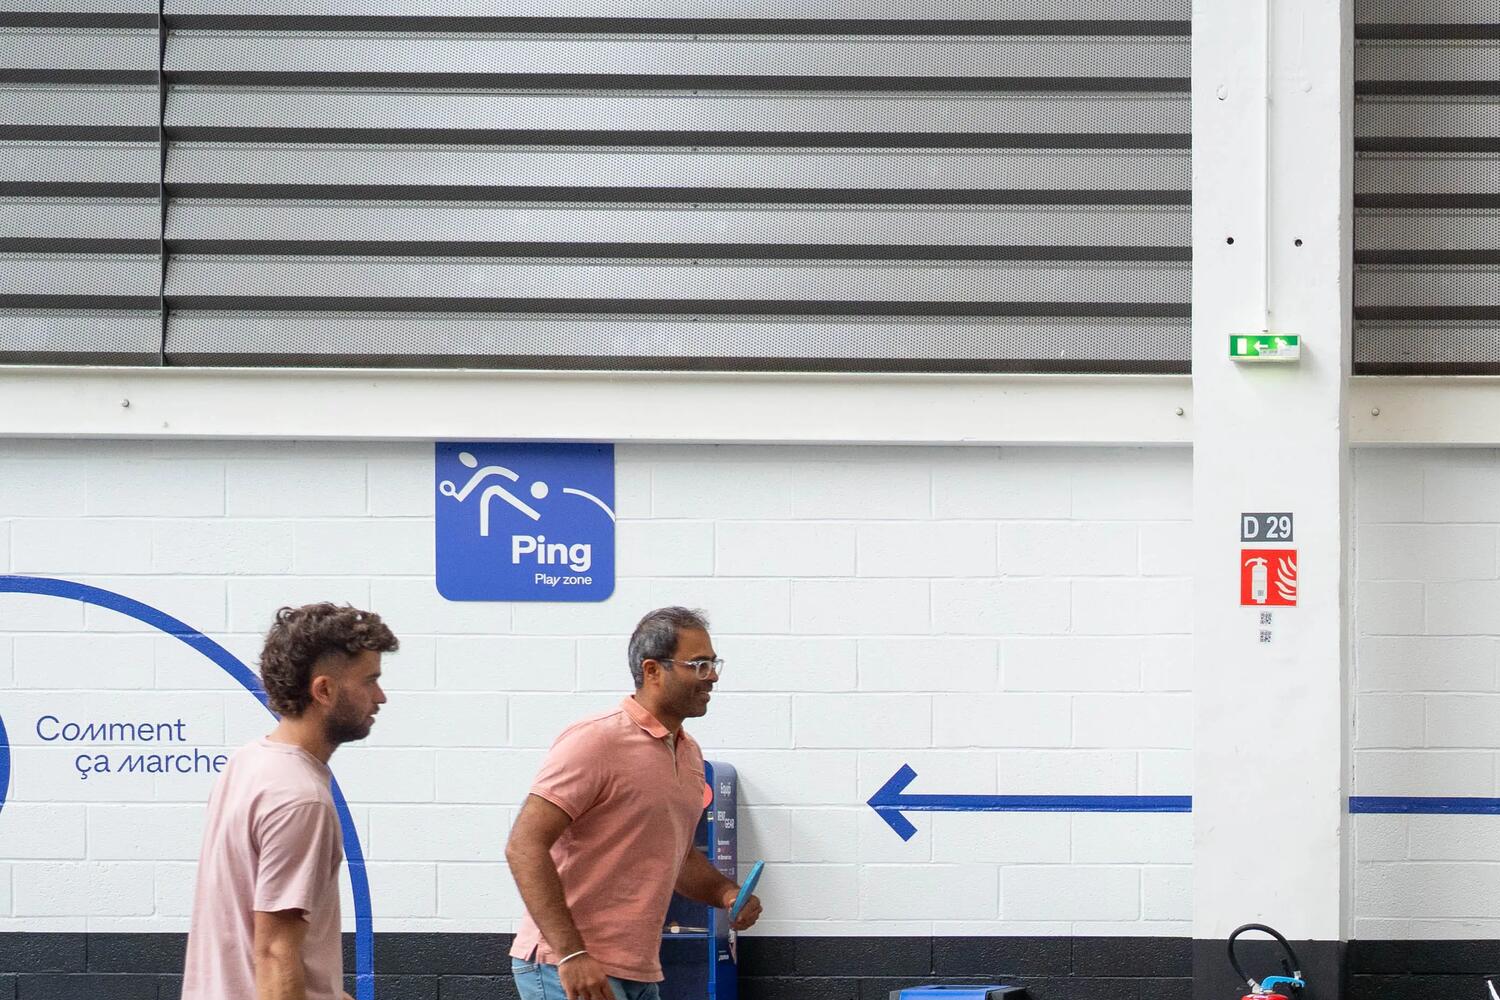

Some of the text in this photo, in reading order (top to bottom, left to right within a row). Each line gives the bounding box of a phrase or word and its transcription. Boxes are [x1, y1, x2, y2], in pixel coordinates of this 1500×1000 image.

[1243, 516, 1291, 539] D 29
[512, 535, 591, 572] Ping
[535, 573, 592, 587] Play zone
[36, 715, 187, 742] Comment
[75, 748, 229, 780] ça marche
